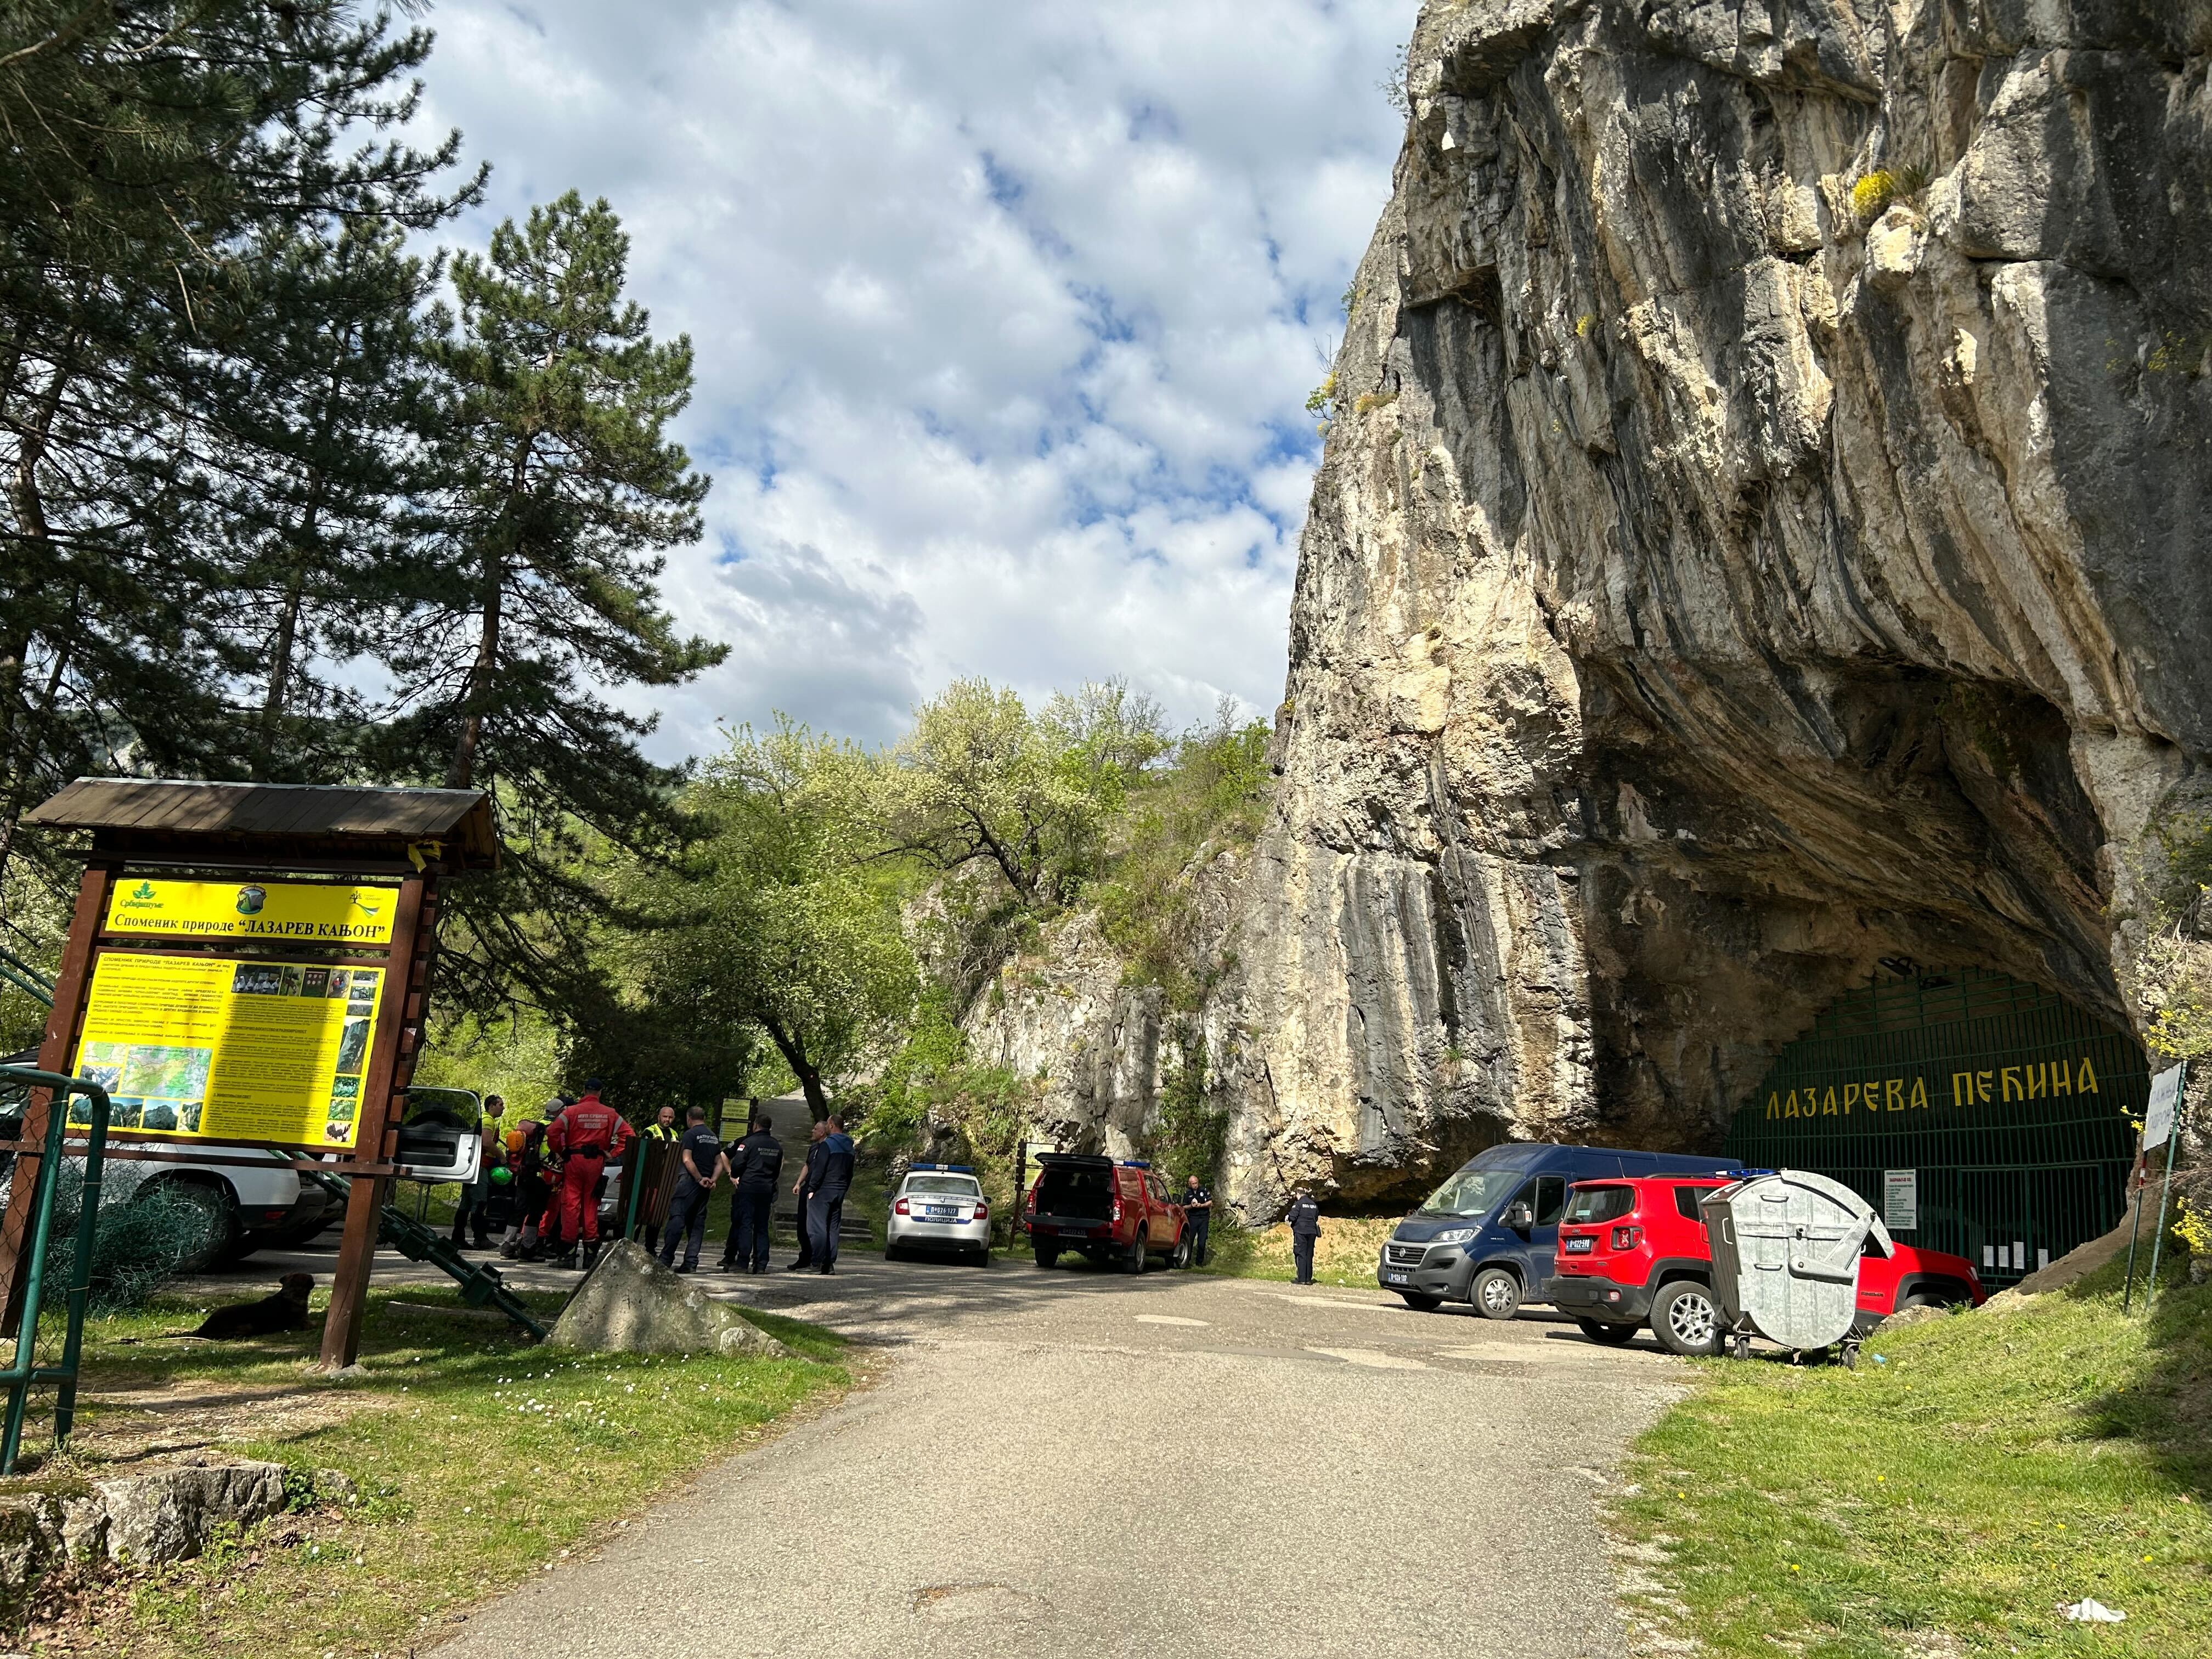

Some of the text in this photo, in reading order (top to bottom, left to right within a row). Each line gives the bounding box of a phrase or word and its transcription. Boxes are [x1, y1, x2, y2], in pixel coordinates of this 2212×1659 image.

[115, 913, 178, 928] Споменик
[182, 920, 234, 932] природе
[1766, 1057, 2099, 1120] ЛАЗАРЕВА ПЕЋИНА
